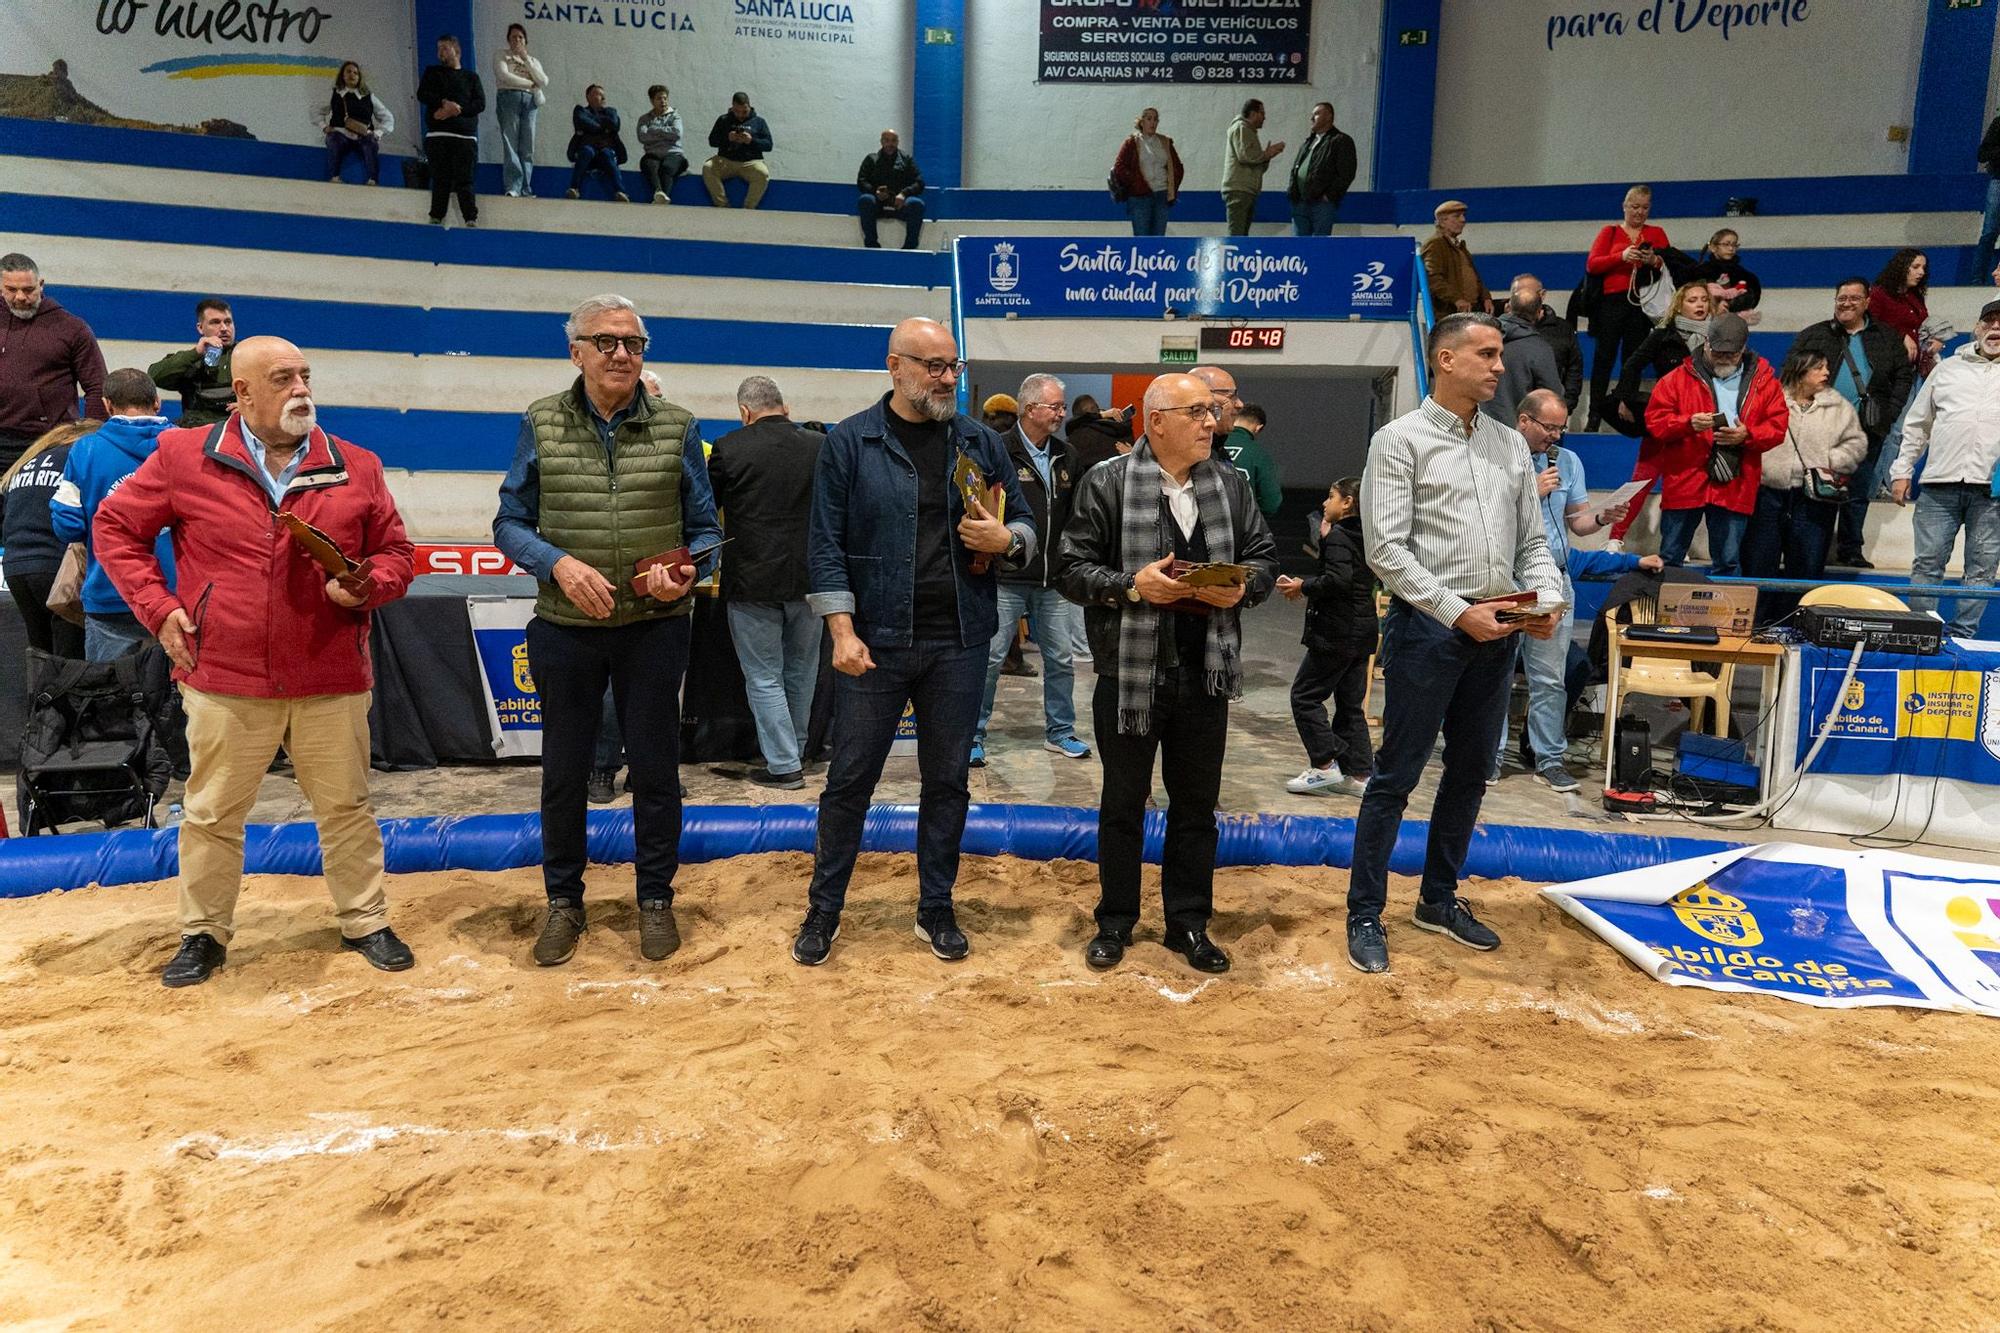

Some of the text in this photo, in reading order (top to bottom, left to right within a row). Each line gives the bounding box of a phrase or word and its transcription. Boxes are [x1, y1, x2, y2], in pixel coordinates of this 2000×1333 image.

[524, 2, 696, 33] SANTA LUCIA
[735, 0, 854, 23] SANTA LUCIA
[1053, 16, 1119, 28] COMPRA
[1131, 17, 1181, 28] VENTA
[1185, 17, 1206, 29] DE
[1547, 0, 1812, 50] para el Deporte
[735, 26, 854, 44] ATENEO MUNICIPAL
[1081, 32, 1257, 44] SERVICIO DE GRUA
[1080, 51, 1090, 62] EN
[1091, 51, 1105, 62] LAS
[1106, 52, 1129, 62] REDES
[1131, 52, 1165, 62] SOCIALES
[1044, 66, 1065, 77] AV/
[1067, 66, 1132, 78] CANARIAS
[1151, 67, 1173, 78] 412
[1207, 67, 1296, 78] 828 133 774
[1059, 243, 1127, 273] Santa
[1126, 247, 1179, 278] Lucía
[1186, 248, 1211, 271] de
[1065, 278, 1300, 309] una ciudad para el Deporte
[1003, 297, 1031, 305] LUCIA
[1163, 352, 1195, 361] SALIDA
[35, 470, 64, 487] RITA
[1927, 692, 1974, 701] INSTITUTO
[1927, 700, 1962, 708] INSULAR
[1825, 714, 1883, 724] Cbildo de
[1926, 708, 1973, 718] DEPORTES
[1847, 723, 1889, 734] Canaria
[1650, 945, 1849, 976] abildo de
[1722, 966, 1893, 991] Canaria
